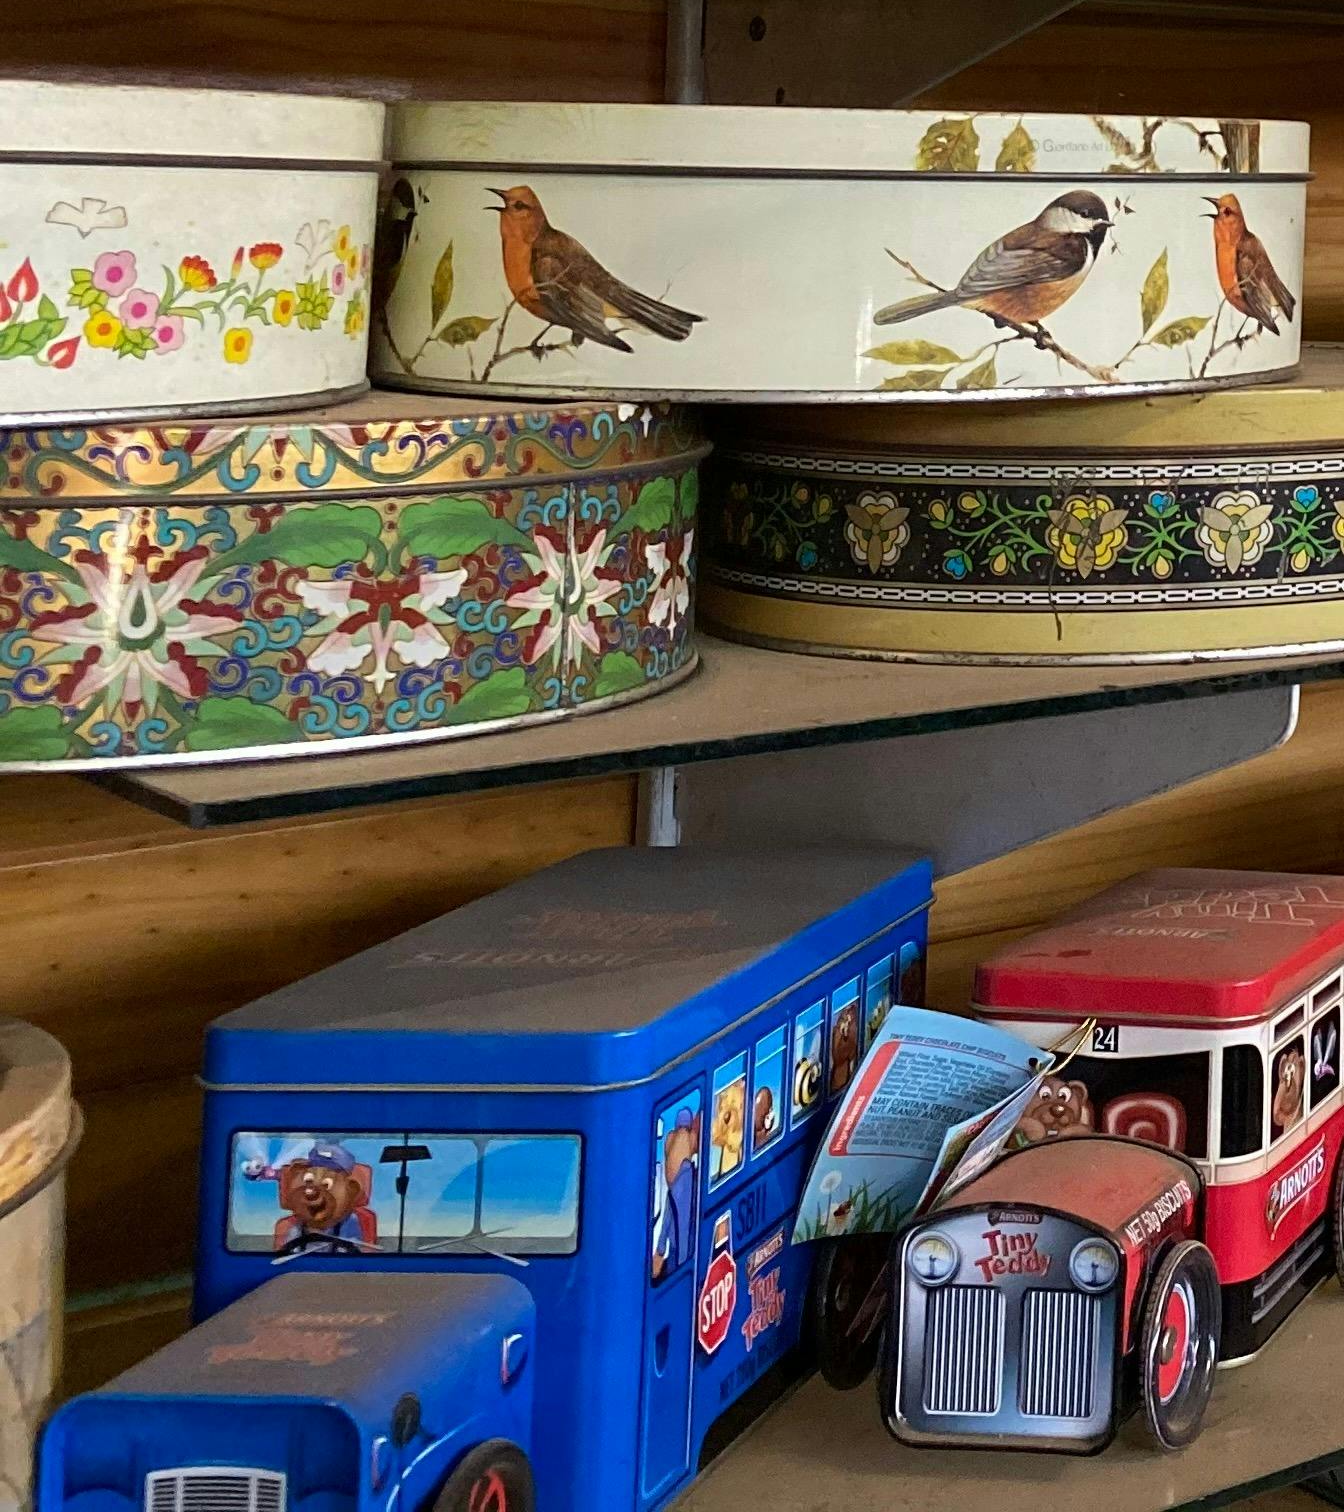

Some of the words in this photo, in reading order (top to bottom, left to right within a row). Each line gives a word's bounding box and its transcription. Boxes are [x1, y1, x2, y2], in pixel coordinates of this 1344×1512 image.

[1094, 1027, 1116, 1051] 24
[873, 1096, 891, 1106] MAY
[891, 1097, 930, 1111] CONTAIN
[1279, 1146, 1324, 1211] ARNOTT'S
[1125, 1215, 1144, 1247] NET
[1143, 1210, 1162, 1233] 50g
[1156, 1179, 1193, 1223] BISCUITS
[981, 1229, 1039, 1258] Tiny
[974, 1248, 1051, 1283] Teddy
[701, 1271, 734, 1334] STOP
